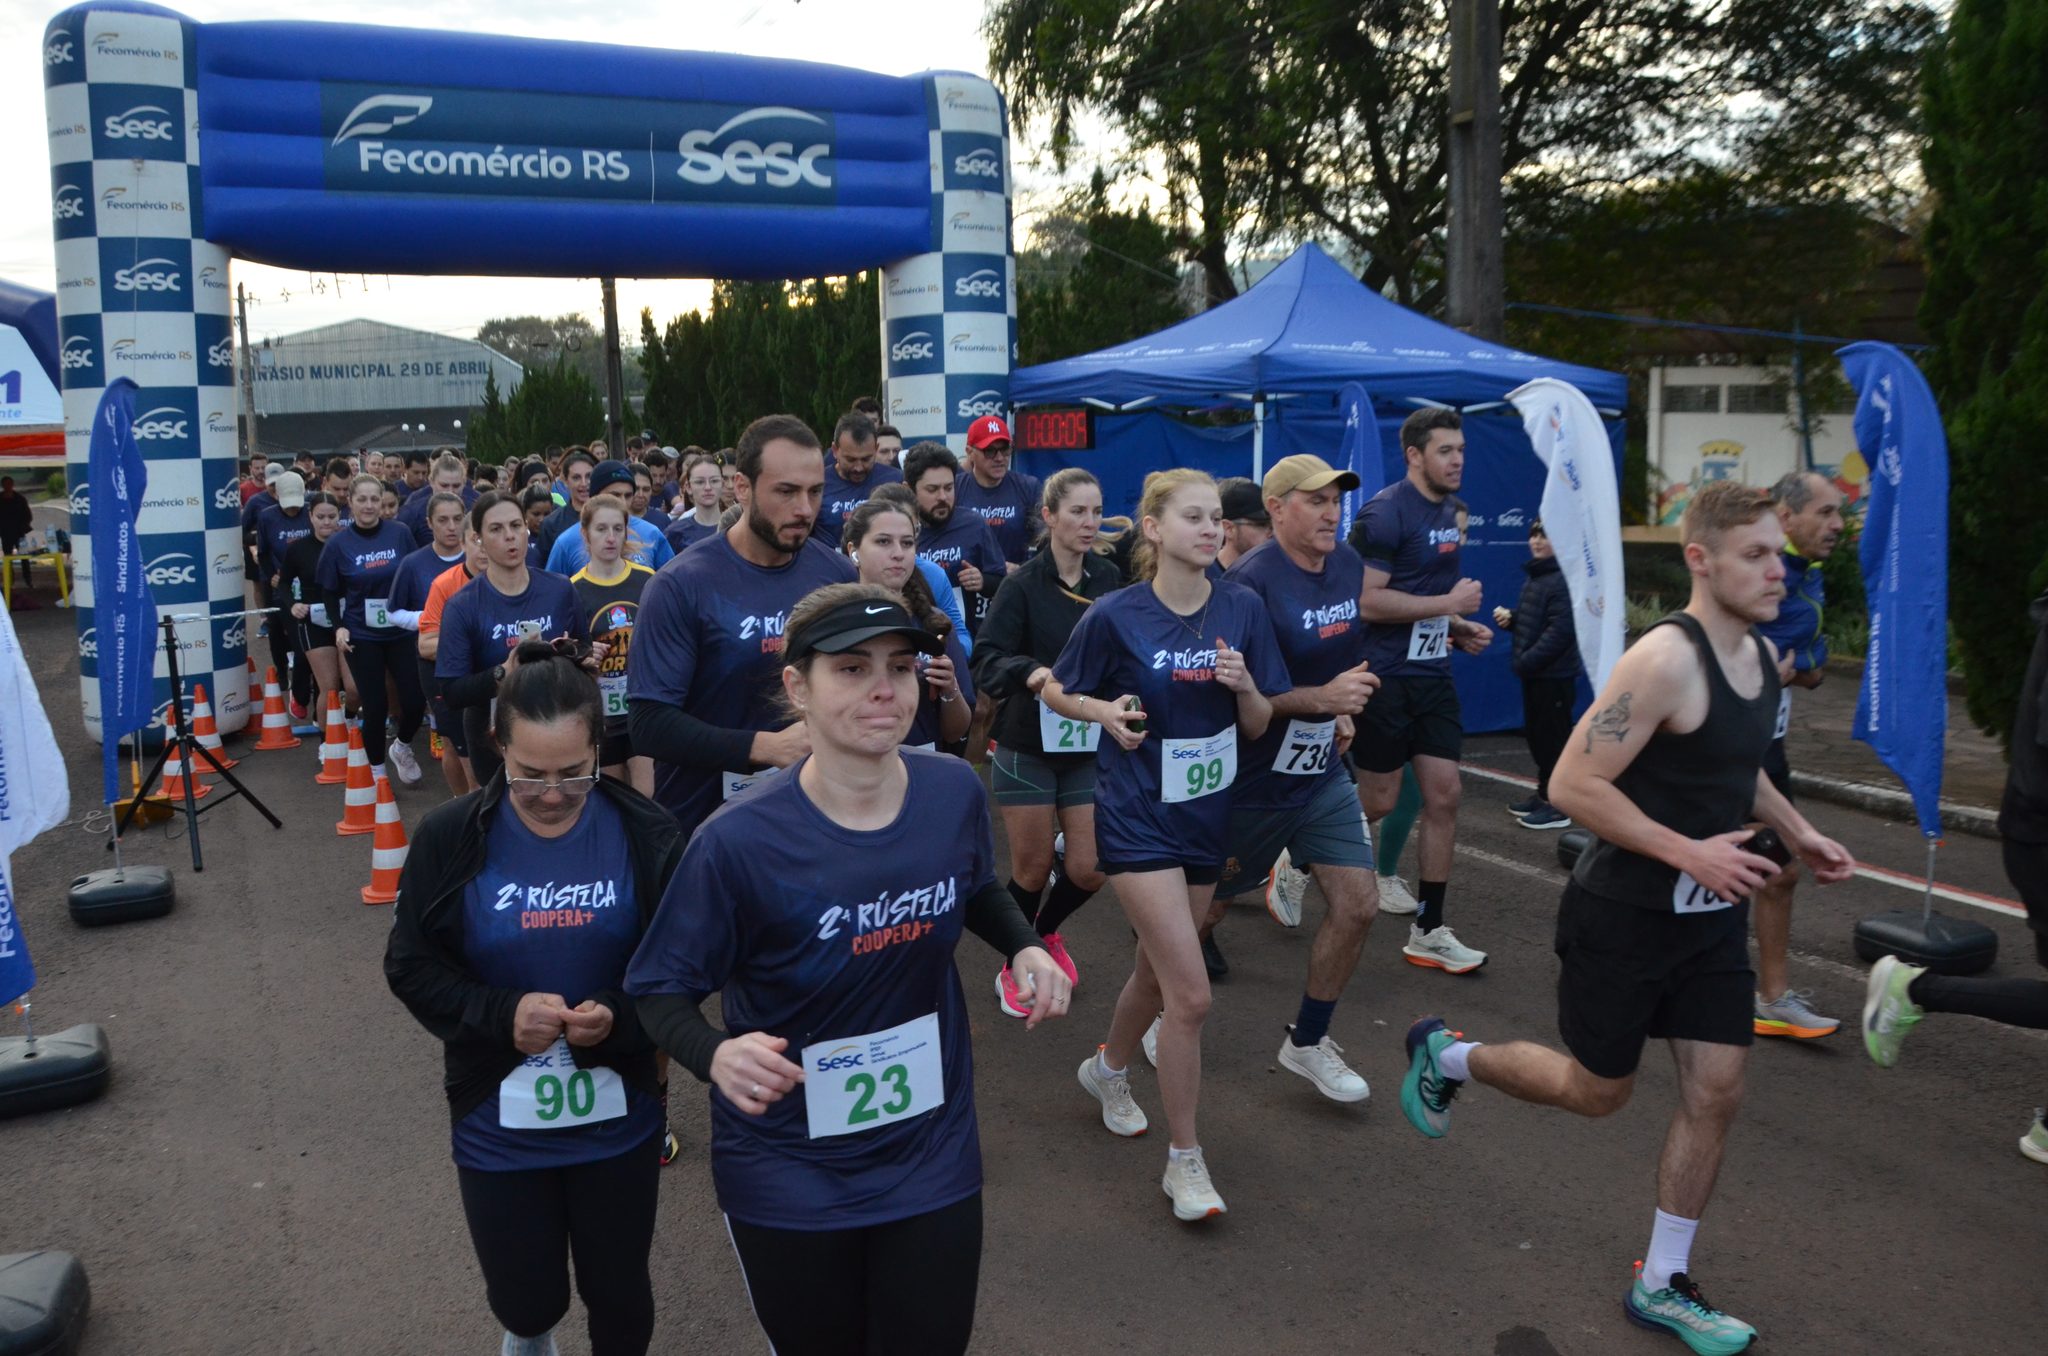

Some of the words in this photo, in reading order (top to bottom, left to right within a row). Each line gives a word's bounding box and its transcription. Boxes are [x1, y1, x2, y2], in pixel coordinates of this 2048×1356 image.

[46, 42, 74, 66] esc
[97, 45, 161, 59] Fecomércio
[163, 50, 178, 61] RS
[104, 115, 173, 141] Sesc
[359, 141, 572, 179] Fecomércio
[582, 150, 630, 182] RS
[677, 129, 832, 188] Sesc
[955, 155, 999, 178] Sesc
[54, 197, 84, 219] esc
[106, 200, 168, 211] Fecomércio
[171, 201, 185, 211] RS
[114, 269, 181, 292] Sesc
[955, 277, 1000, 297] Sesc
[116, 351, 176, 361] Fecomércio
[179, 351, 192, 361] RS
[891, 341, 934, 361] Sesc
[310, 363, 395, 380] MUNICIPAL
[401, 362, 420, 376] 29
[424, 361, 444, 376] DE
[449, 361, 489, 376] ABRIL
[958, 399, 1003, 417] Sesc
[186, 497, 200, 506] RS
[116, 521, 129, 594] Sindicatos
[147, 565, 195, 585] esc
[1058, 720, 1087, 748] 21
[1293, 730, 1317, 740] Sesc
[1172, 749, 1202, 759] Sesc
[1187, 758, 1223, 796] 99
[494, 882, 523, 911] 2ª
[527, 880, 617, 909] RÚSTICA
[521, 909, 595, 929] COOPERA+
[817, 905, 851, 940] 2ª
[858, 877, 957, 935] RÚSTICA
[852, 920, 935, 955] COOPERA+
[817, 1052, 864, 1072] Sesc
[534, 1069, 595, 1121] 90
[844, 1064, 912, 1125] 23
